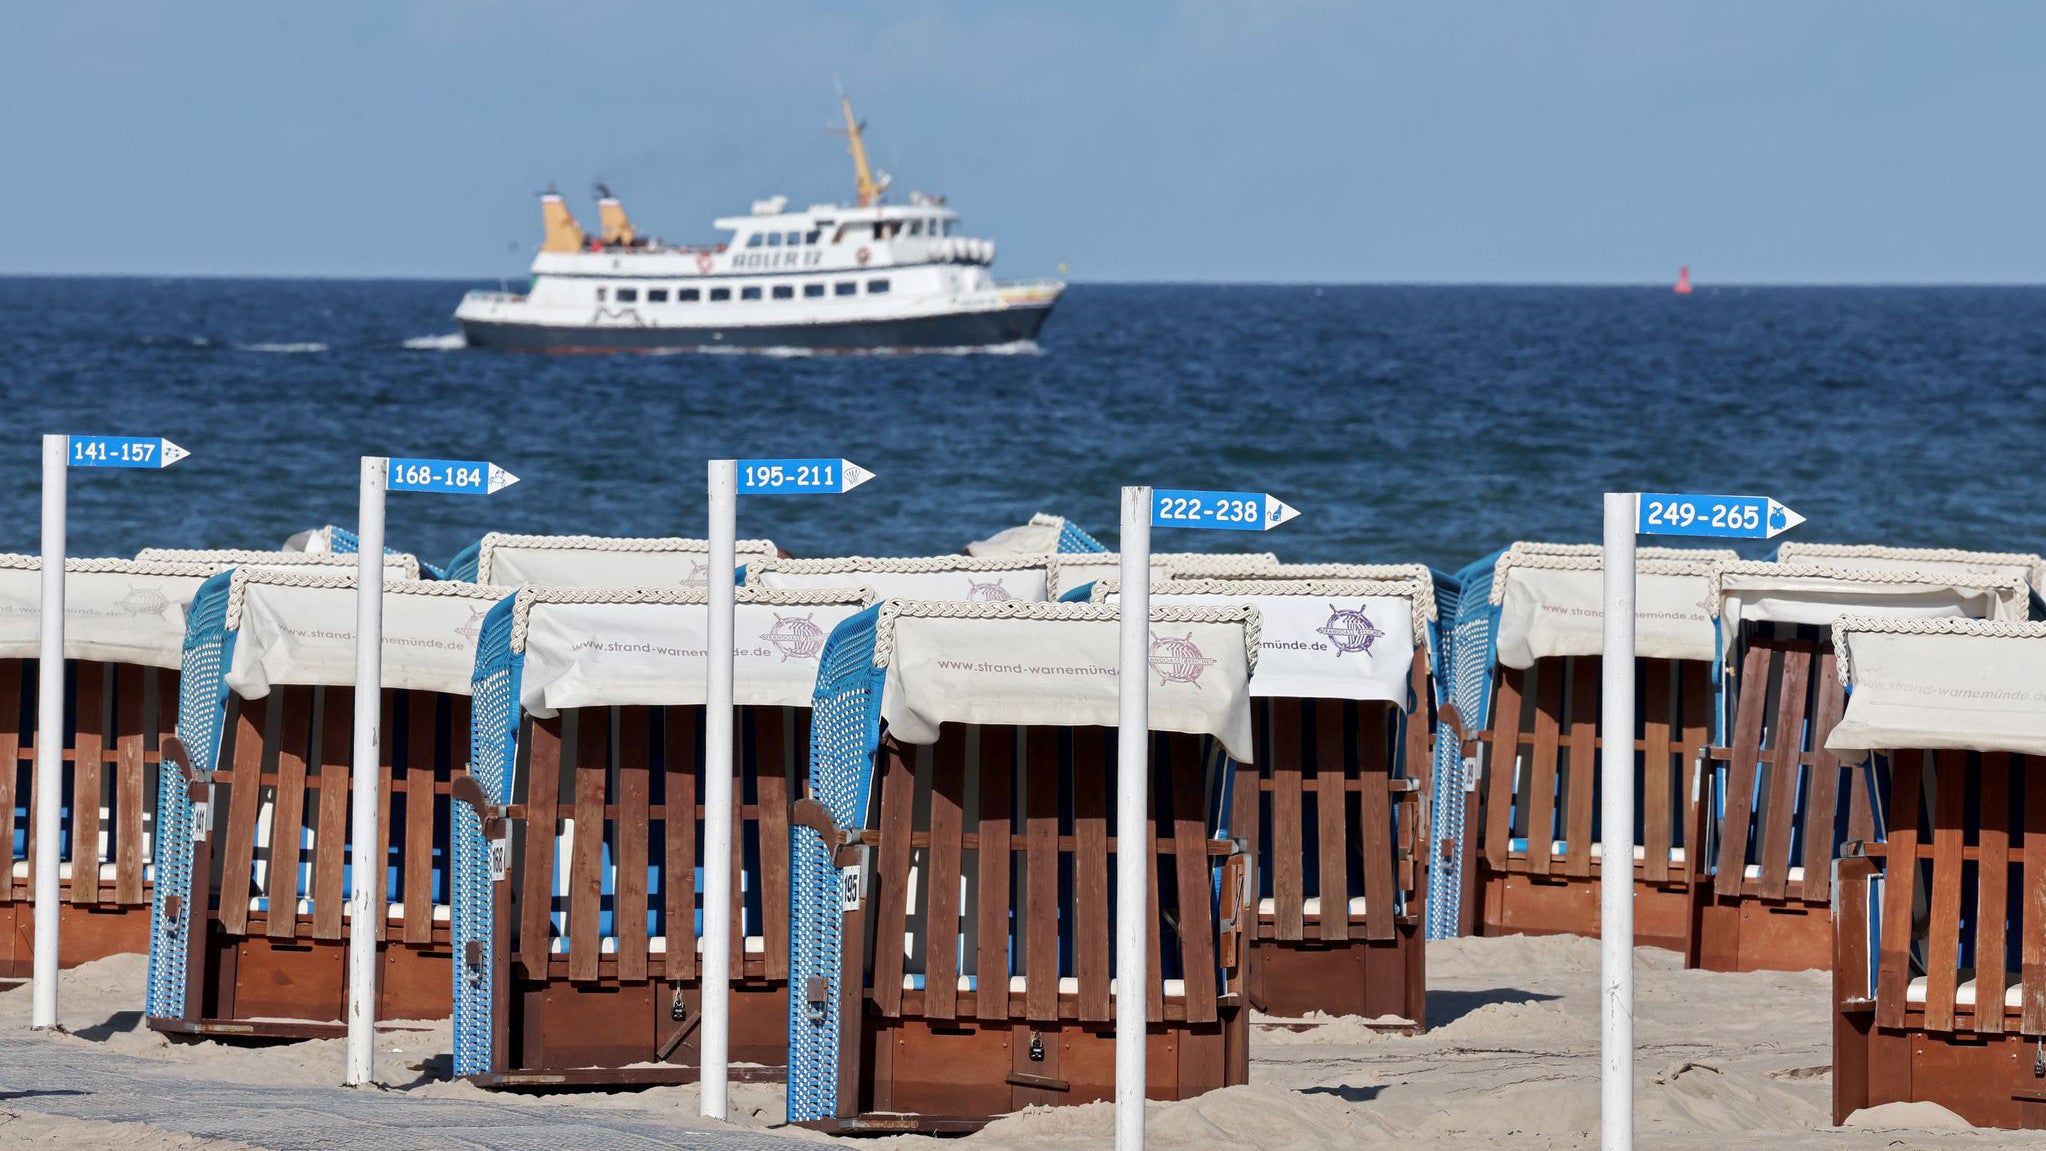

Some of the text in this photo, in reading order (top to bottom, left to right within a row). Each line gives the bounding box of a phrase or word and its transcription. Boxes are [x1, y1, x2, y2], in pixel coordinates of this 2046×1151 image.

[75, 441, 156, 462] 141-157
[395, 464, 481, 487] 168-184
[745, 465, 834, 487] 195-211
[1160, 497, 1258, 523] 222-238
[1648, 501, 1760, 530] 249-265
[844, 874, 858, 903] 195
